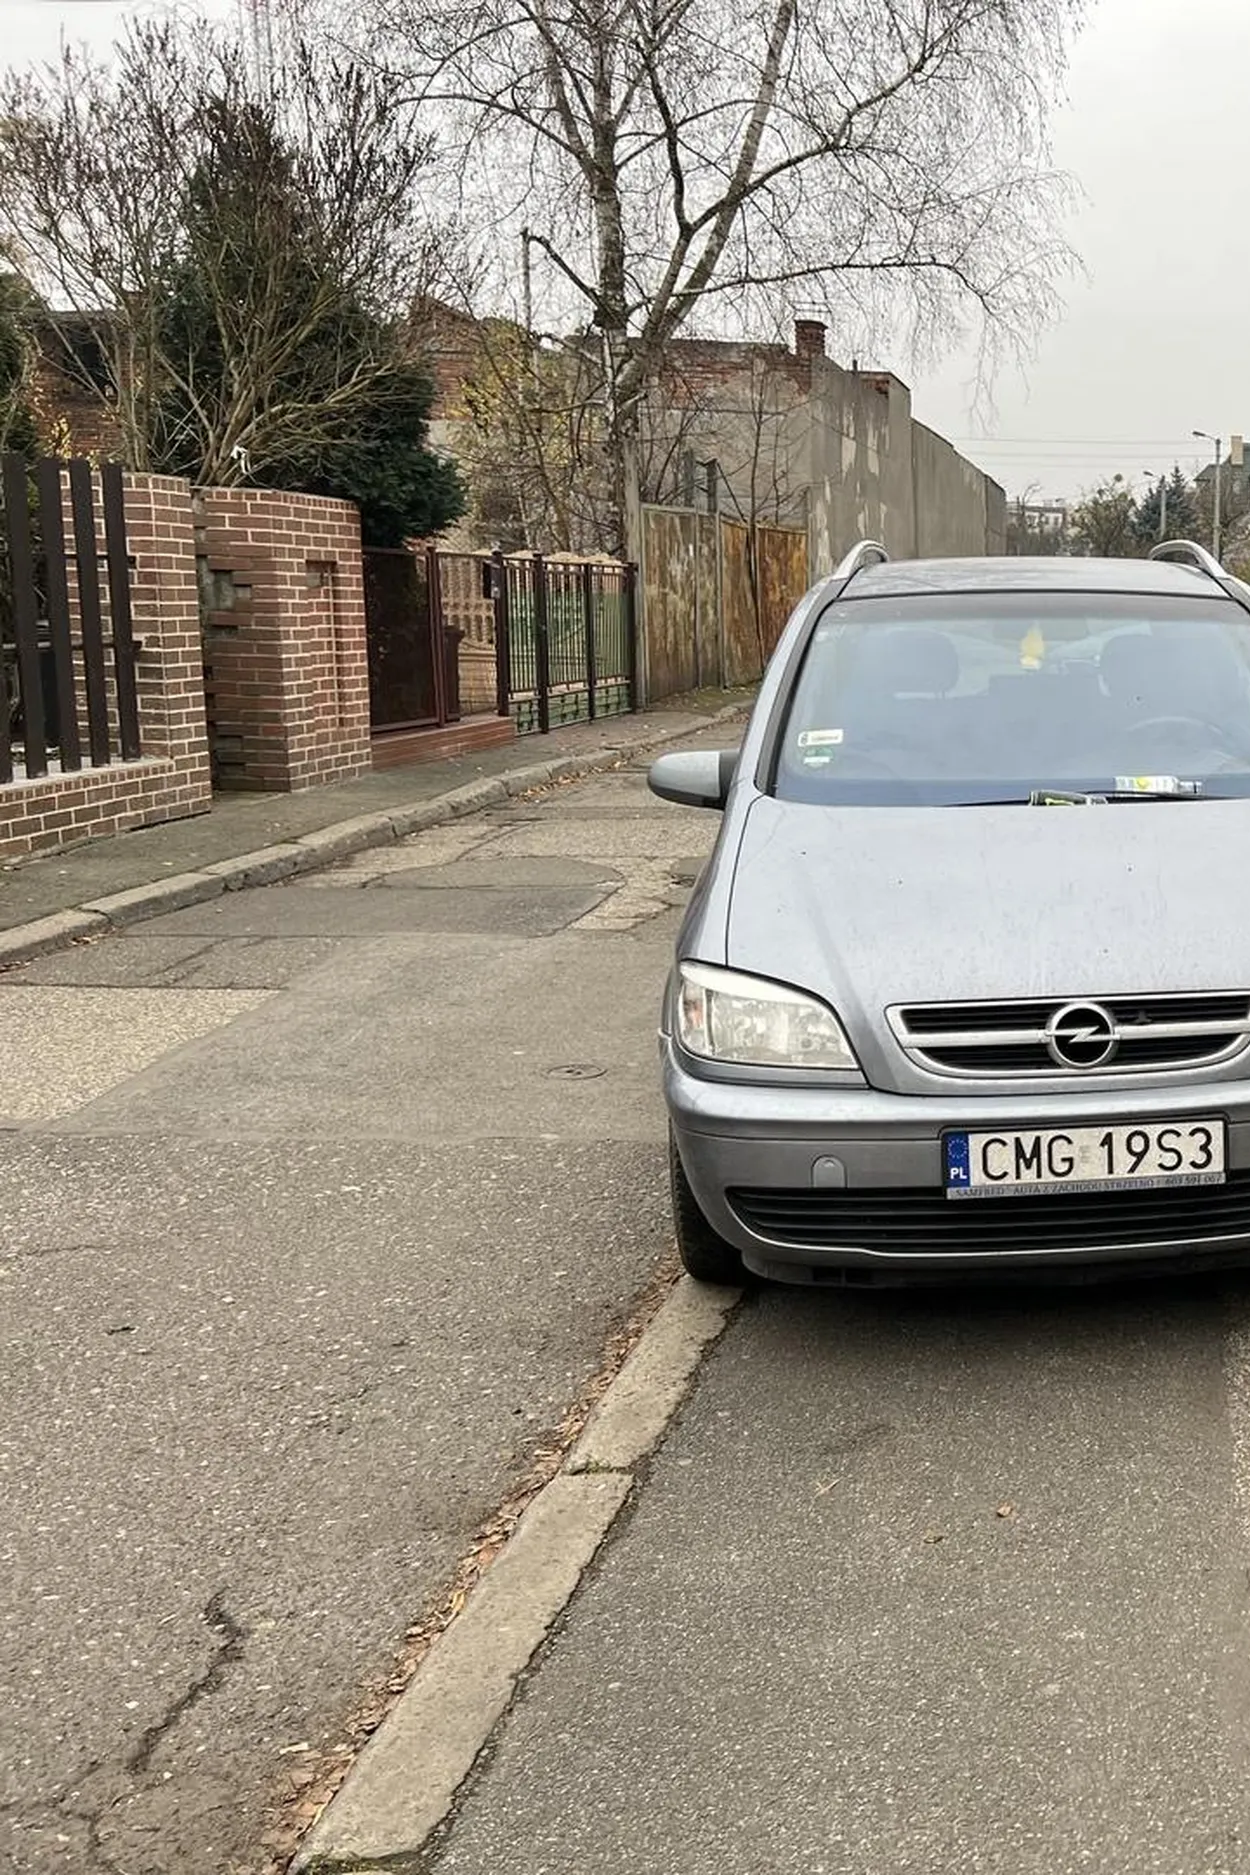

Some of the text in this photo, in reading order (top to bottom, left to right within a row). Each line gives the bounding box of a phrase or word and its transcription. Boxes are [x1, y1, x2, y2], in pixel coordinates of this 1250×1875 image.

[981, 1127, 1214, 1181] CMG 19S3
[950, 1167, 967, 1180] PL
